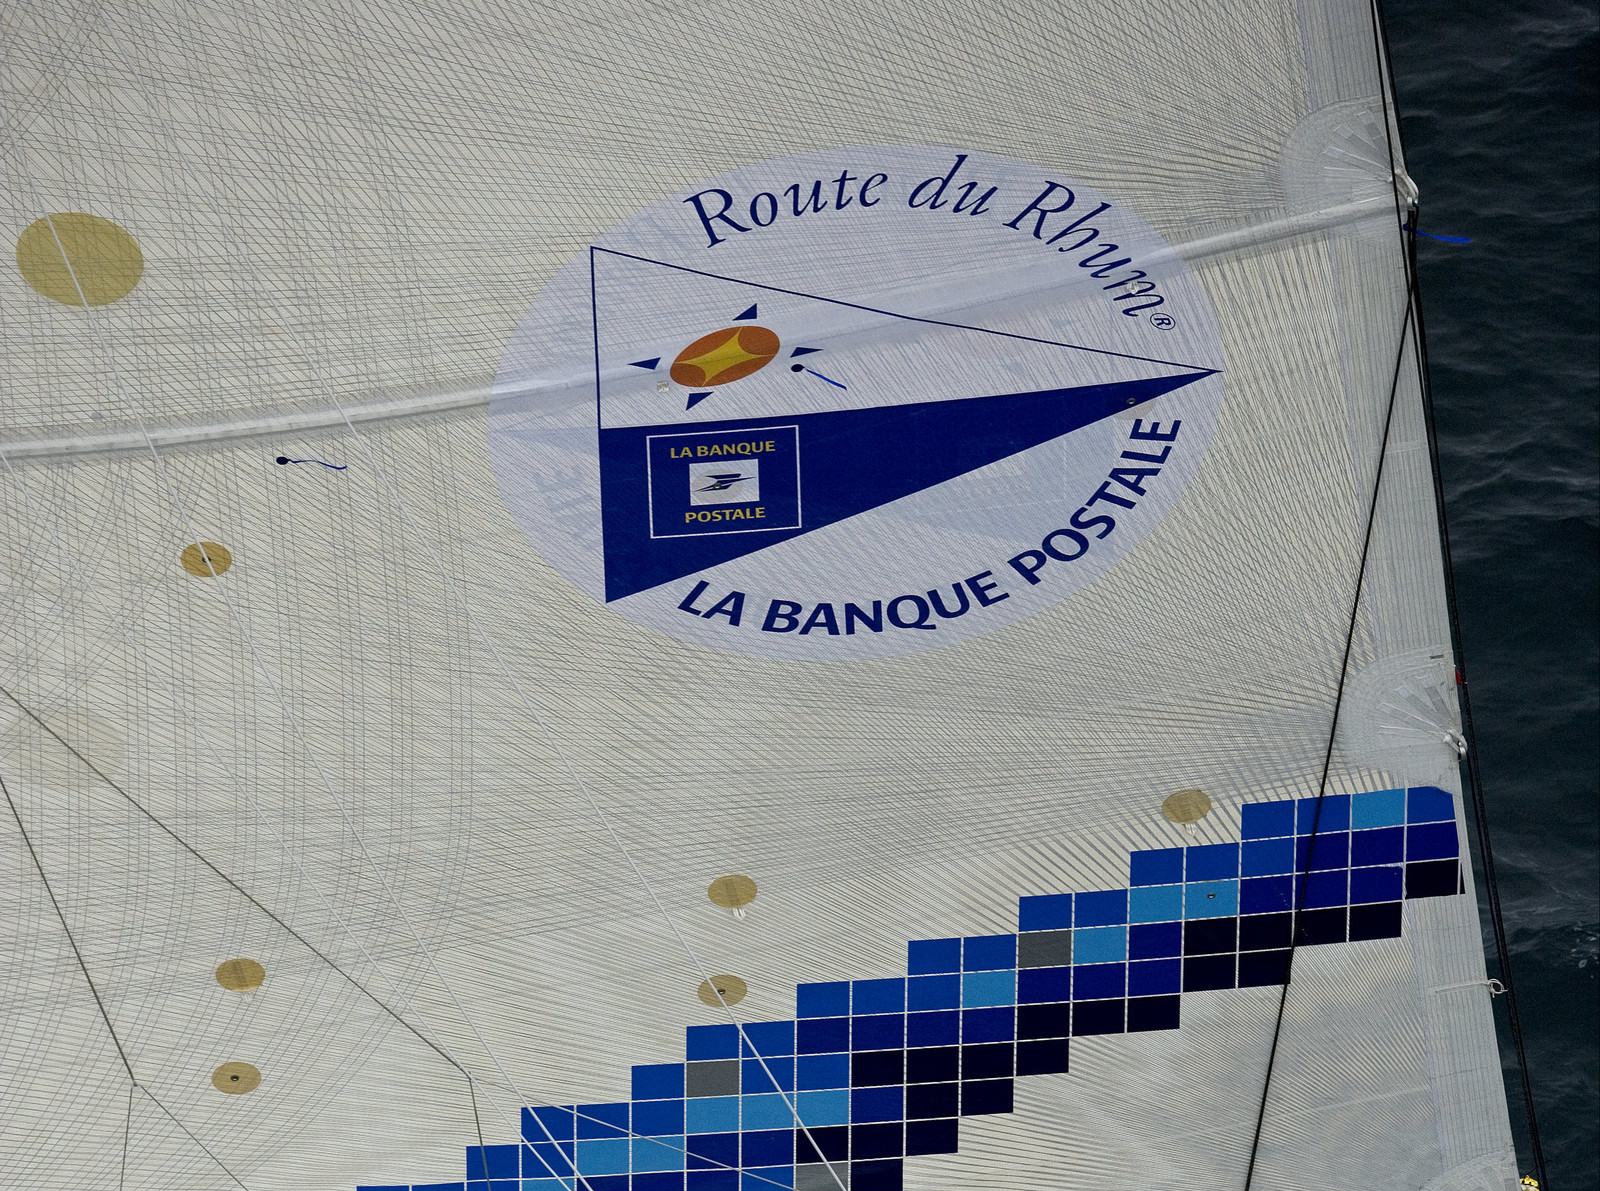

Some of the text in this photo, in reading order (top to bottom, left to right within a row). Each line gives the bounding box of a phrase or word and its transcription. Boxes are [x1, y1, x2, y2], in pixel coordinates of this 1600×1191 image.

[682, 169, 890, 249] Route
[907, 154, 998, 217] du
[670, 440, 776, 459] LA BANQUE
[676, 417, 1183, 636] LA BANQUE POSTALE
[684, 506, 766, 524] POSTALE
